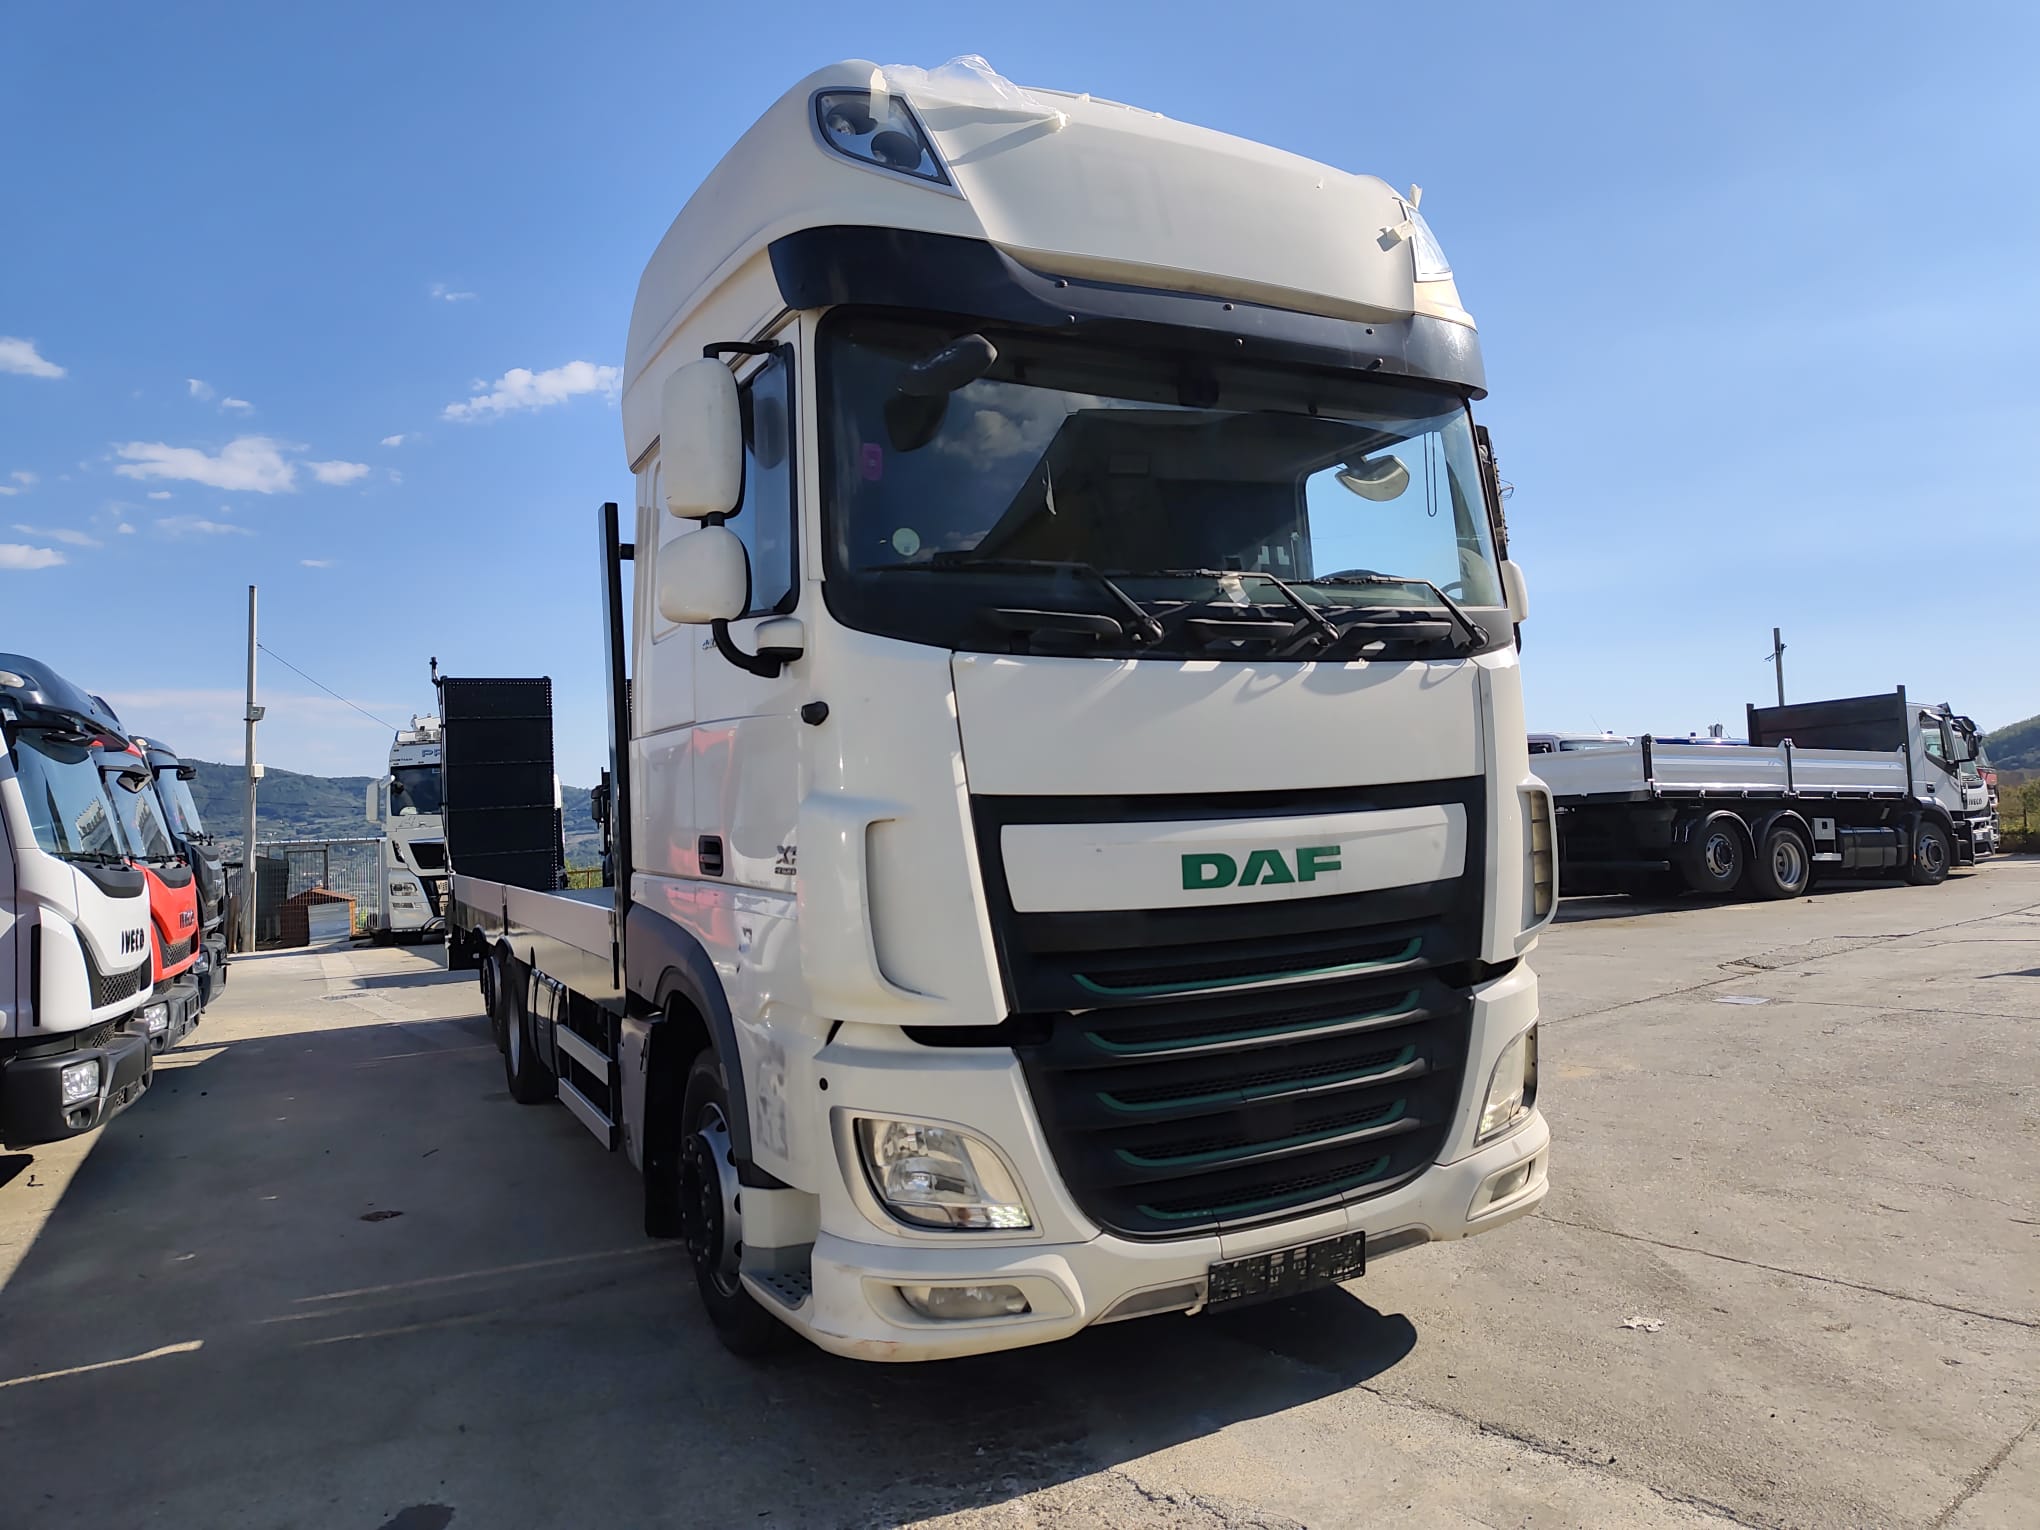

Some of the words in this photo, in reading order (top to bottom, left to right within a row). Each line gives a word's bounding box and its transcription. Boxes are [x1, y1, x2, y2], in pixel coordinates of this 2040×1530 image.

[1968, 798, 1983, 806] IVECO
[1181, 845, 1342, 890] DAF
[120, 928, 145, 955] IVECO
